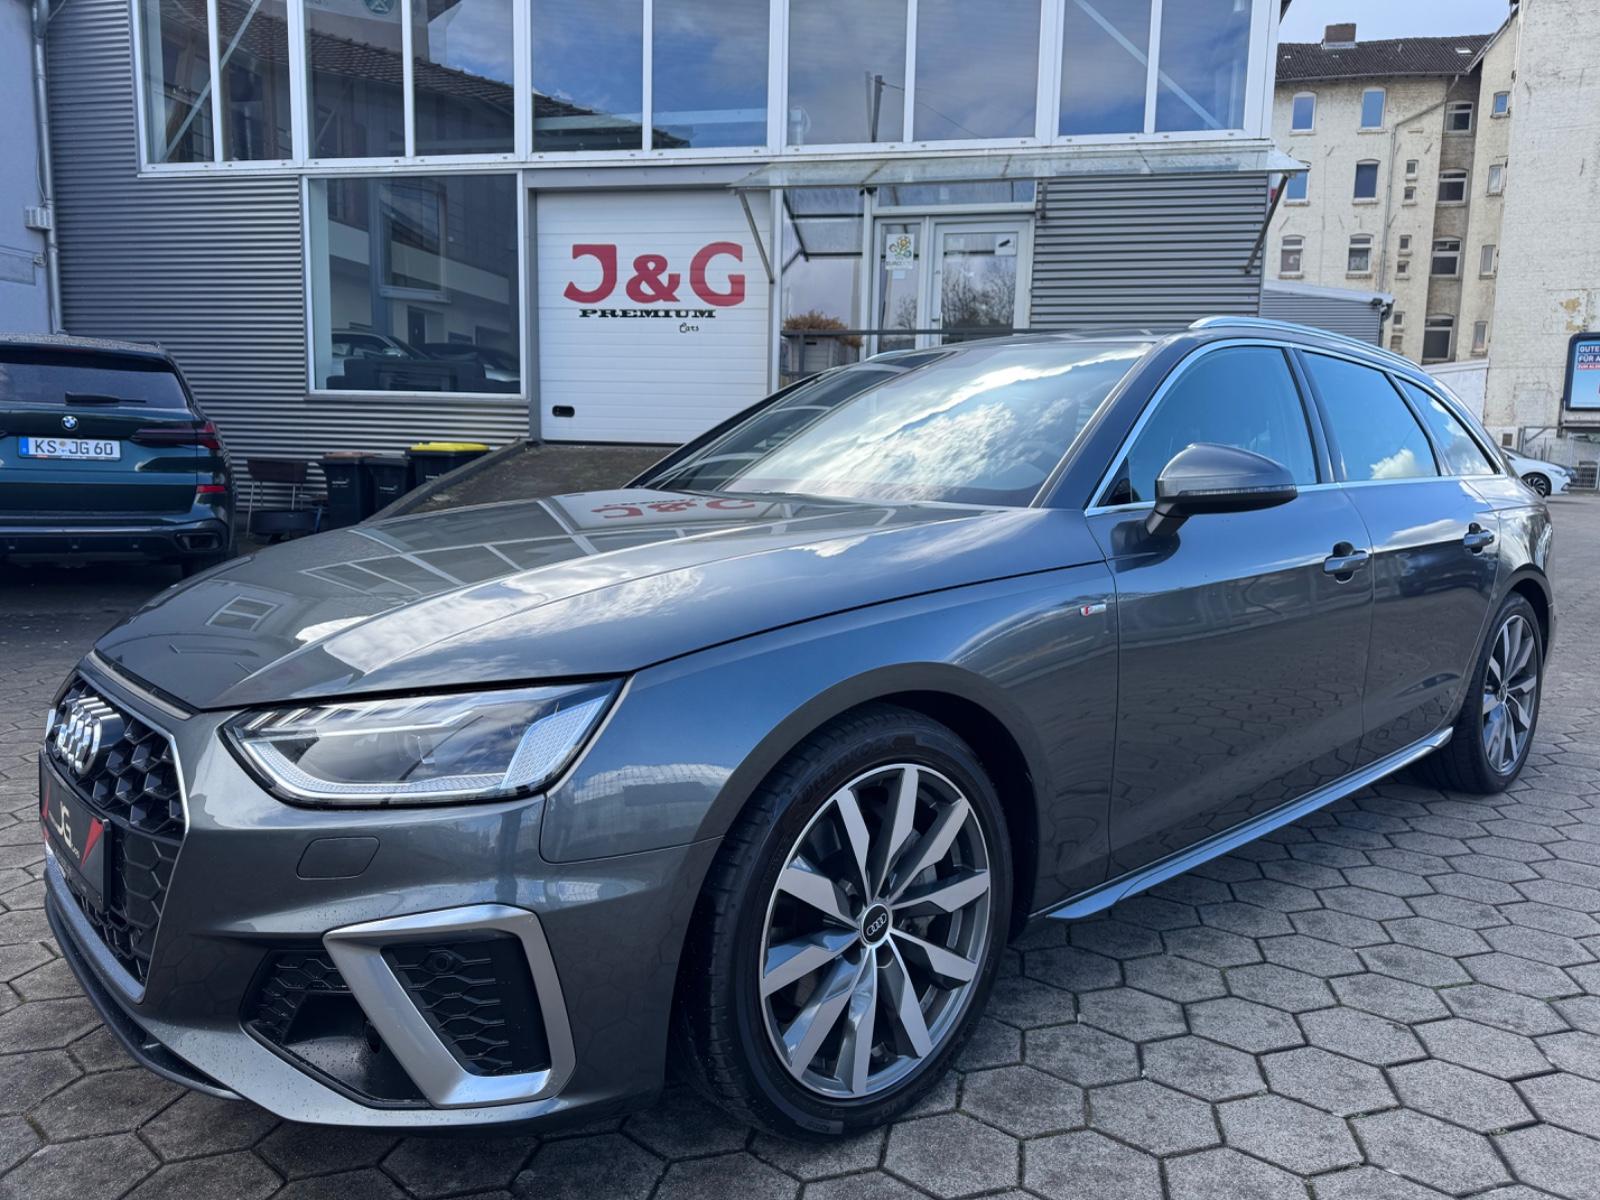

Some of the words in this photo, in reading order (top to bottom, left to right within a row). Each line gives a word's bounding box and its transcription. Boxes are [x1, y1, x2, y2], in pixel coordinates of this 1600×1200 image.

[563, 241, 745, 307] J&G
[579, 308, 716, 318] PREMIUM
[679, 322, 699, 333] Cars
[35, 440, 57, 454] KS
[69, 441, 90, 455] JG
[94, 442, 113, 456] 60
